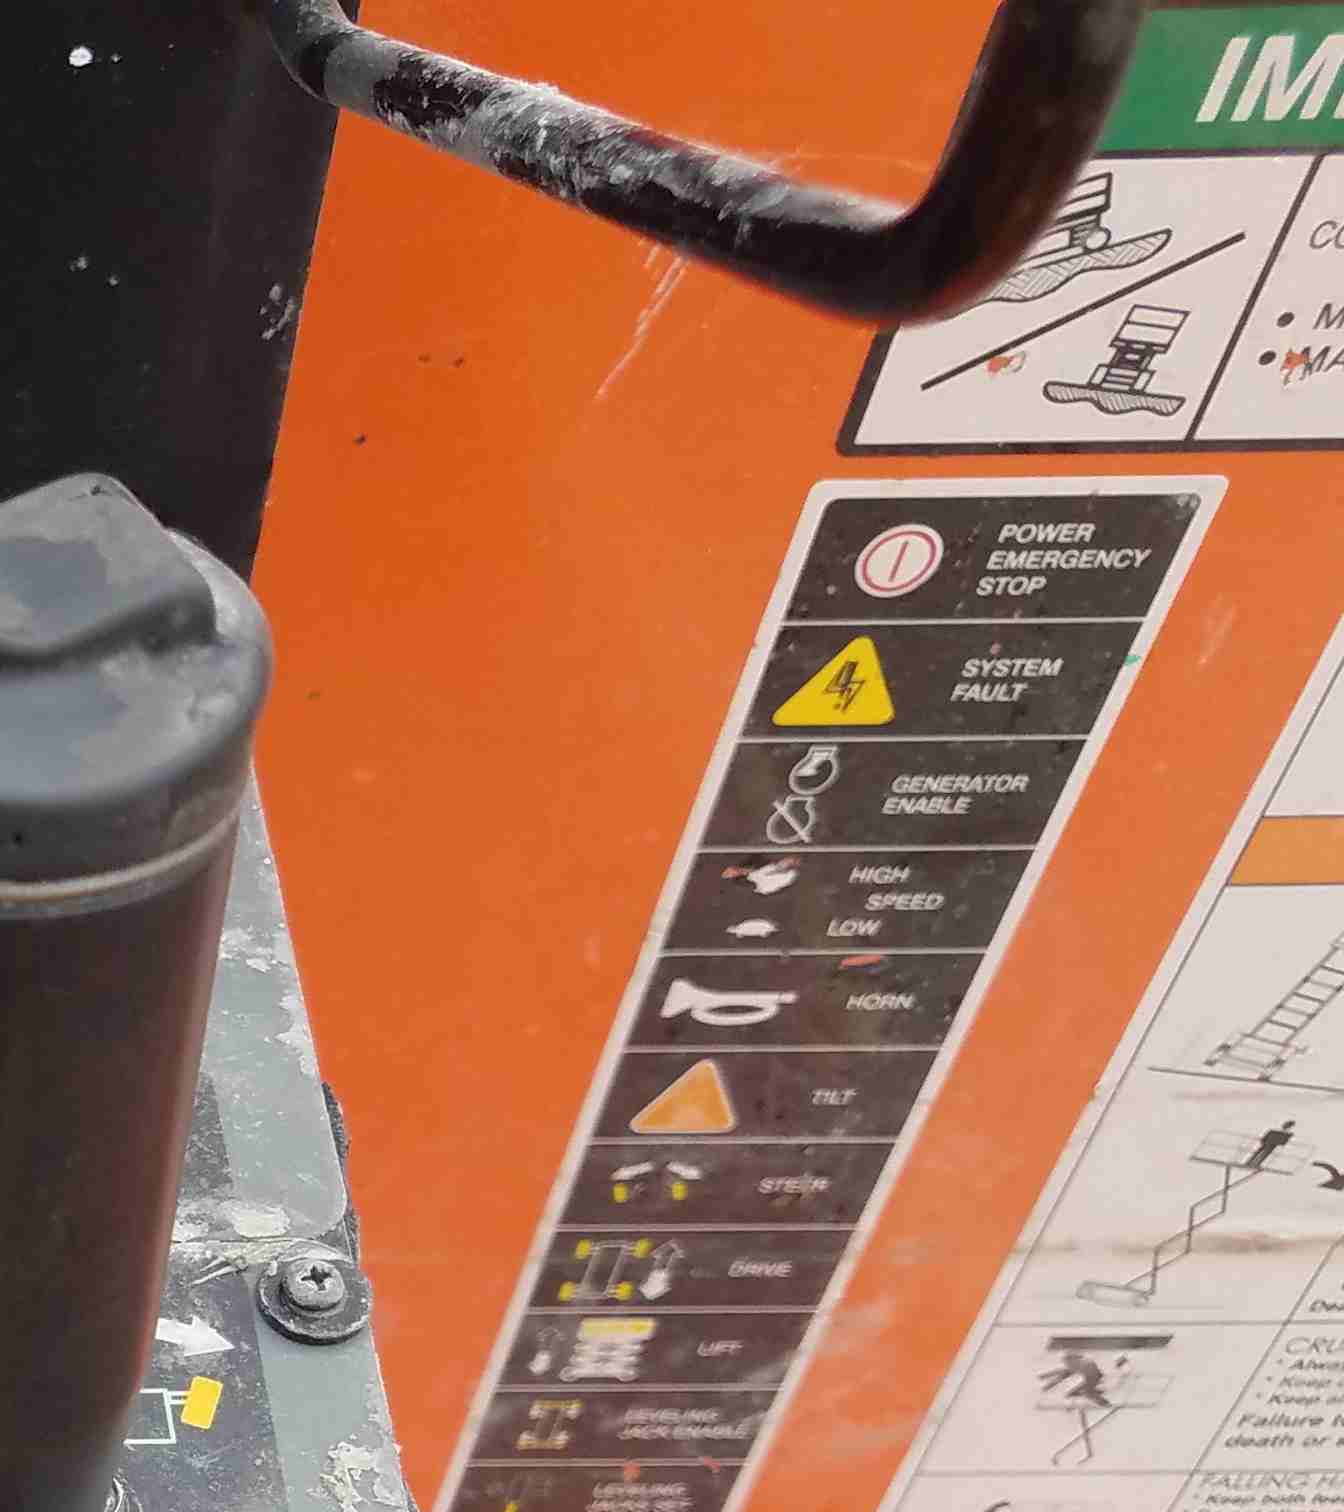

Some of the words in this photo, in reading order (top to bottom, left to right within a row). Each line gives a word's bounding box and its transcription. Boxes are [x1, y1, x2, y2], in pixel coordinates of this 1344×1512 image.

[1194, 34, 1344, 123] IM
[998, 523, 1097, 544] POWER
[986, 548, 1152, 570] EMERGENCY
[976, 576, 1047, 597] STOP
[961, 658, 1064, 678] SYSTEM
[950, 682, 1028, 702] FAULT
[891, 774, 1029, 794] GENERATOR
[881, 797, 971, 815] ENABLE
[848, 866, 911, 884] HIGH
[864, 893, 945, 911] SPEED
[826, 919, 882, 937] LOW
[846, 993, 915, 1010] HORN
[812, 1088, 858, 1105] TILT
[728, 1261, 793, 1278] DRIVE
[1237, 1412, 1325, 1428] Failure
